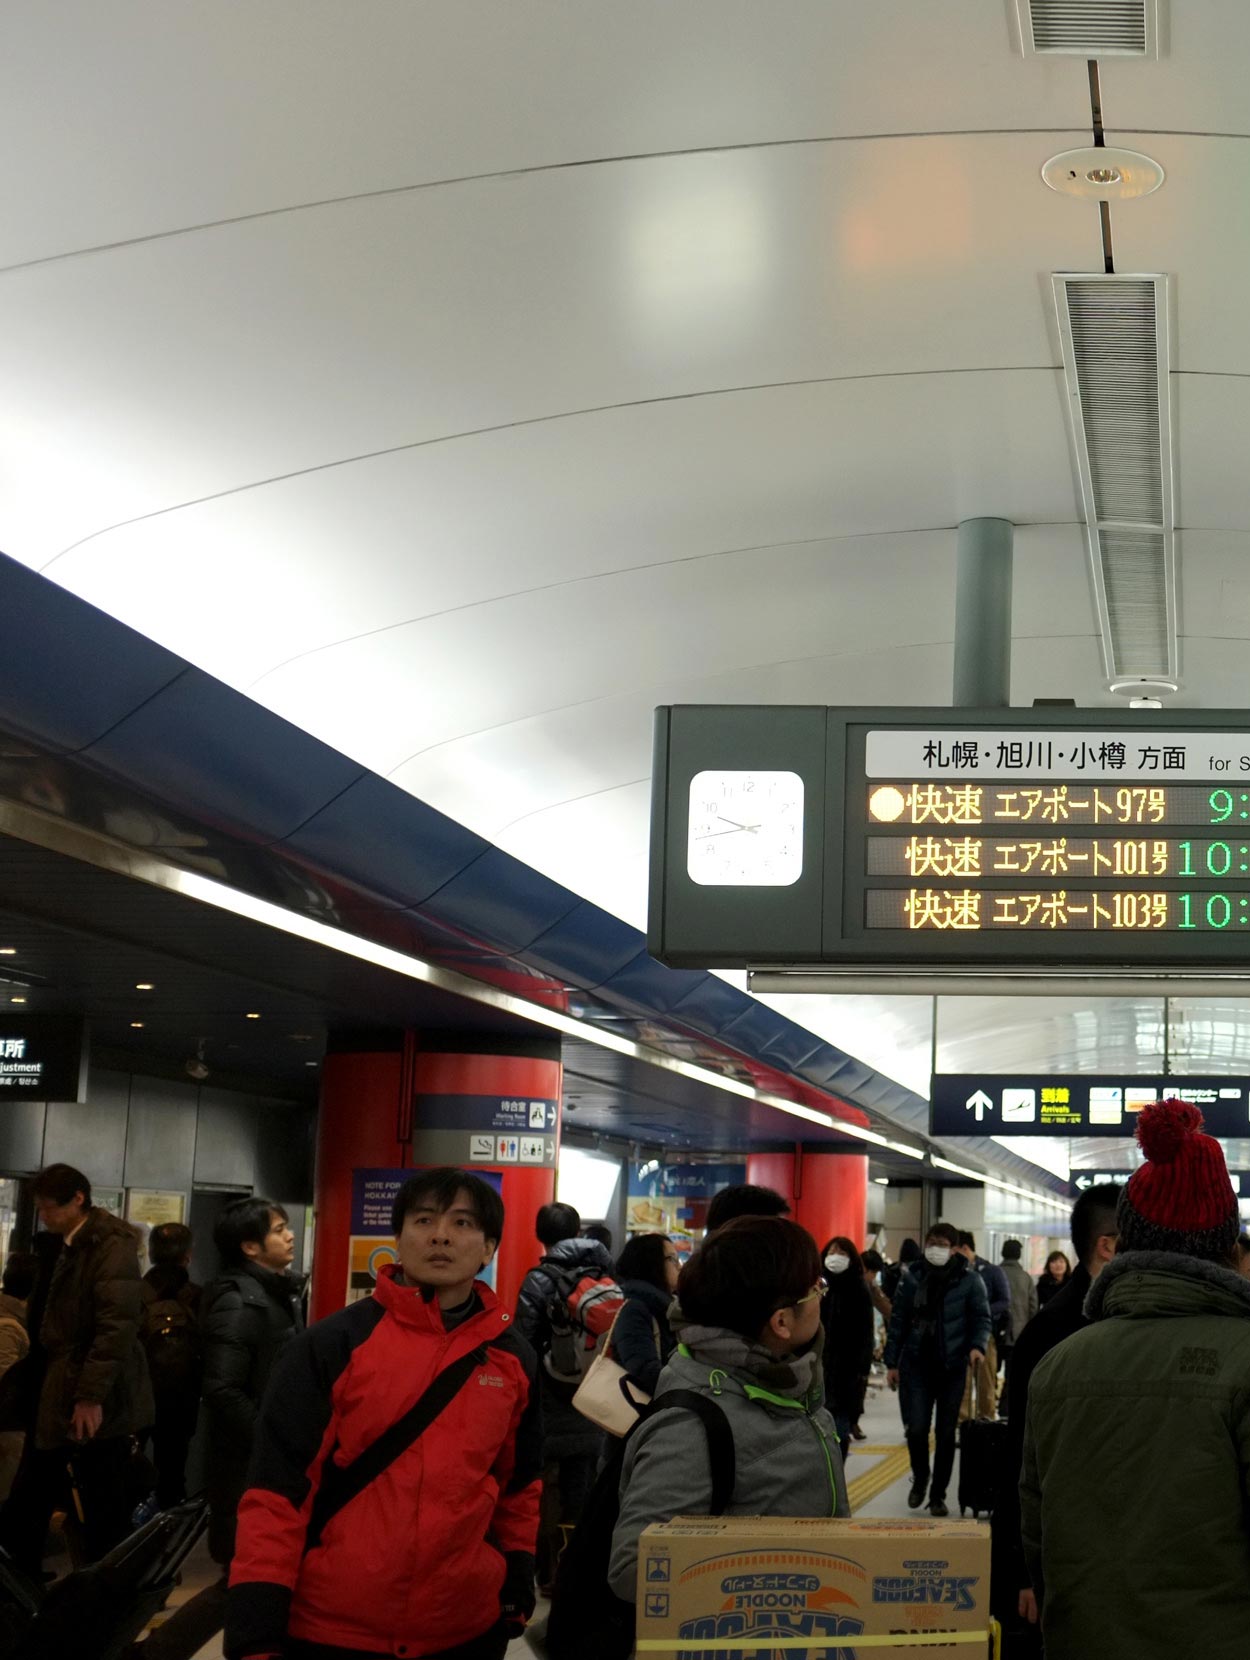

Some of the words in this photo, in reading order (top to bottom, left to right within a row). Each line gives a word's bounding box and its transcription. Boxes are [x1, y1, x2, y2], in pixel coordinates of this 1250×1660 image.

[922, 739, 1127, 771] 札幌・旭川・小樽
[1137, 745, 1187, 771] 方面
[1208, 755, 1231, 771] for
[904, 785, 982, 824] 快速
[994, 786, 1166, 824] エアポート97号
[904, 839, 982, 877] 快速
[993, 839, 1169, 877] エアポート101号
[903, 892, 982, 930] 快速
[992, 892, 1168, 930] エアポート103号
[1041, 1088, 1069, 1103] 到着
[1041, 1105, 1069, 1113] Arrivals
[910, 1569, 942, 1577] NOODLE
[723, 1576, 817, 1591] シーフードヌードル
[734, 1593, 806, 1609] NOODLE
[872, 1576, 980, 1612] SEAFOOD
